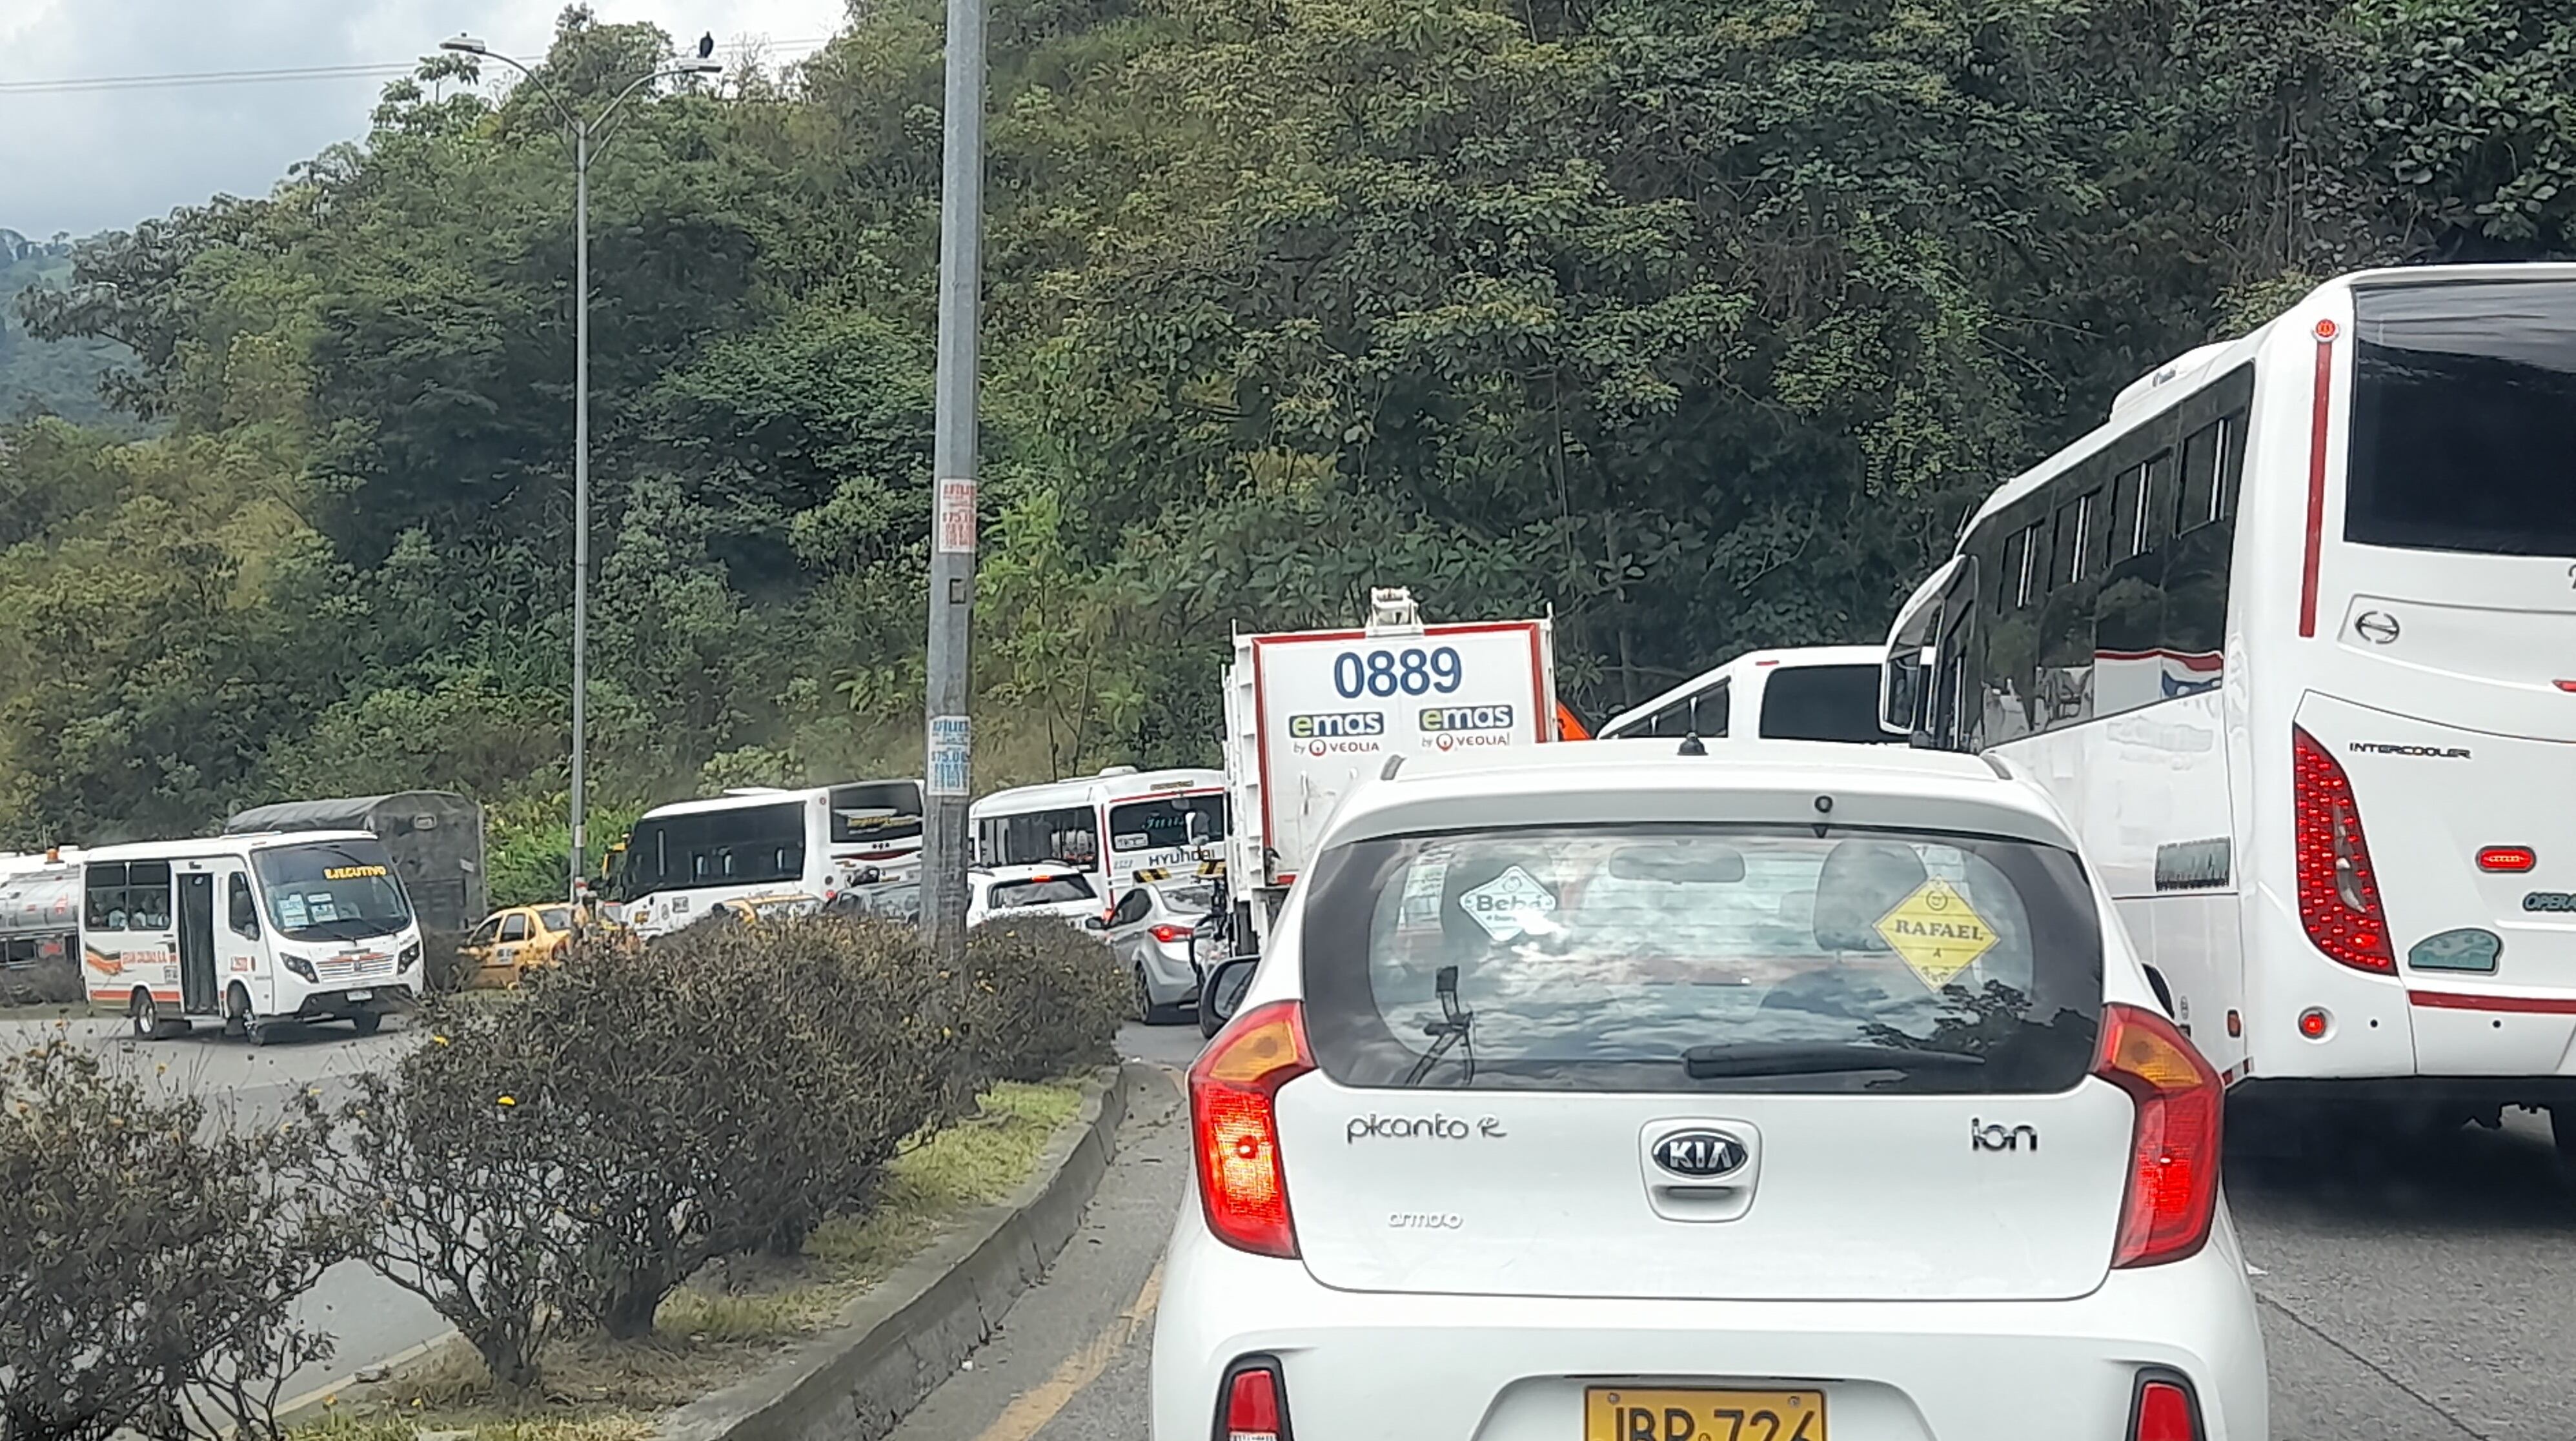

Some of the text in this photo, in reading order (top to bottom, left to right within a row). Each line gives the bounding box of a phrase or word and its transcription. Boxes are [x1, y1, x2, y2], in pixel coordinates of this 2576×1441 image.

[1334, 647, 1462, 698] 0889
[1292, 713, 1381, 737] emas
[1423, 707, 1510, 731] emas
[1293, 741, 1379, 754] by VEOLIA
[1421, 734, 1507, 748] by VEOLIA
[2349, 742, 2471, 759] INTERCOOLER
[323, 865, 387, 879] EJECUTIVO
[1895, 919, 1984, 941] RAFAEL
[1346, 1113, 1469, 1144] picanto
[1971, 1117, 2038, 1152] ion
[1670, 1141, 1733, 1169] KIA
